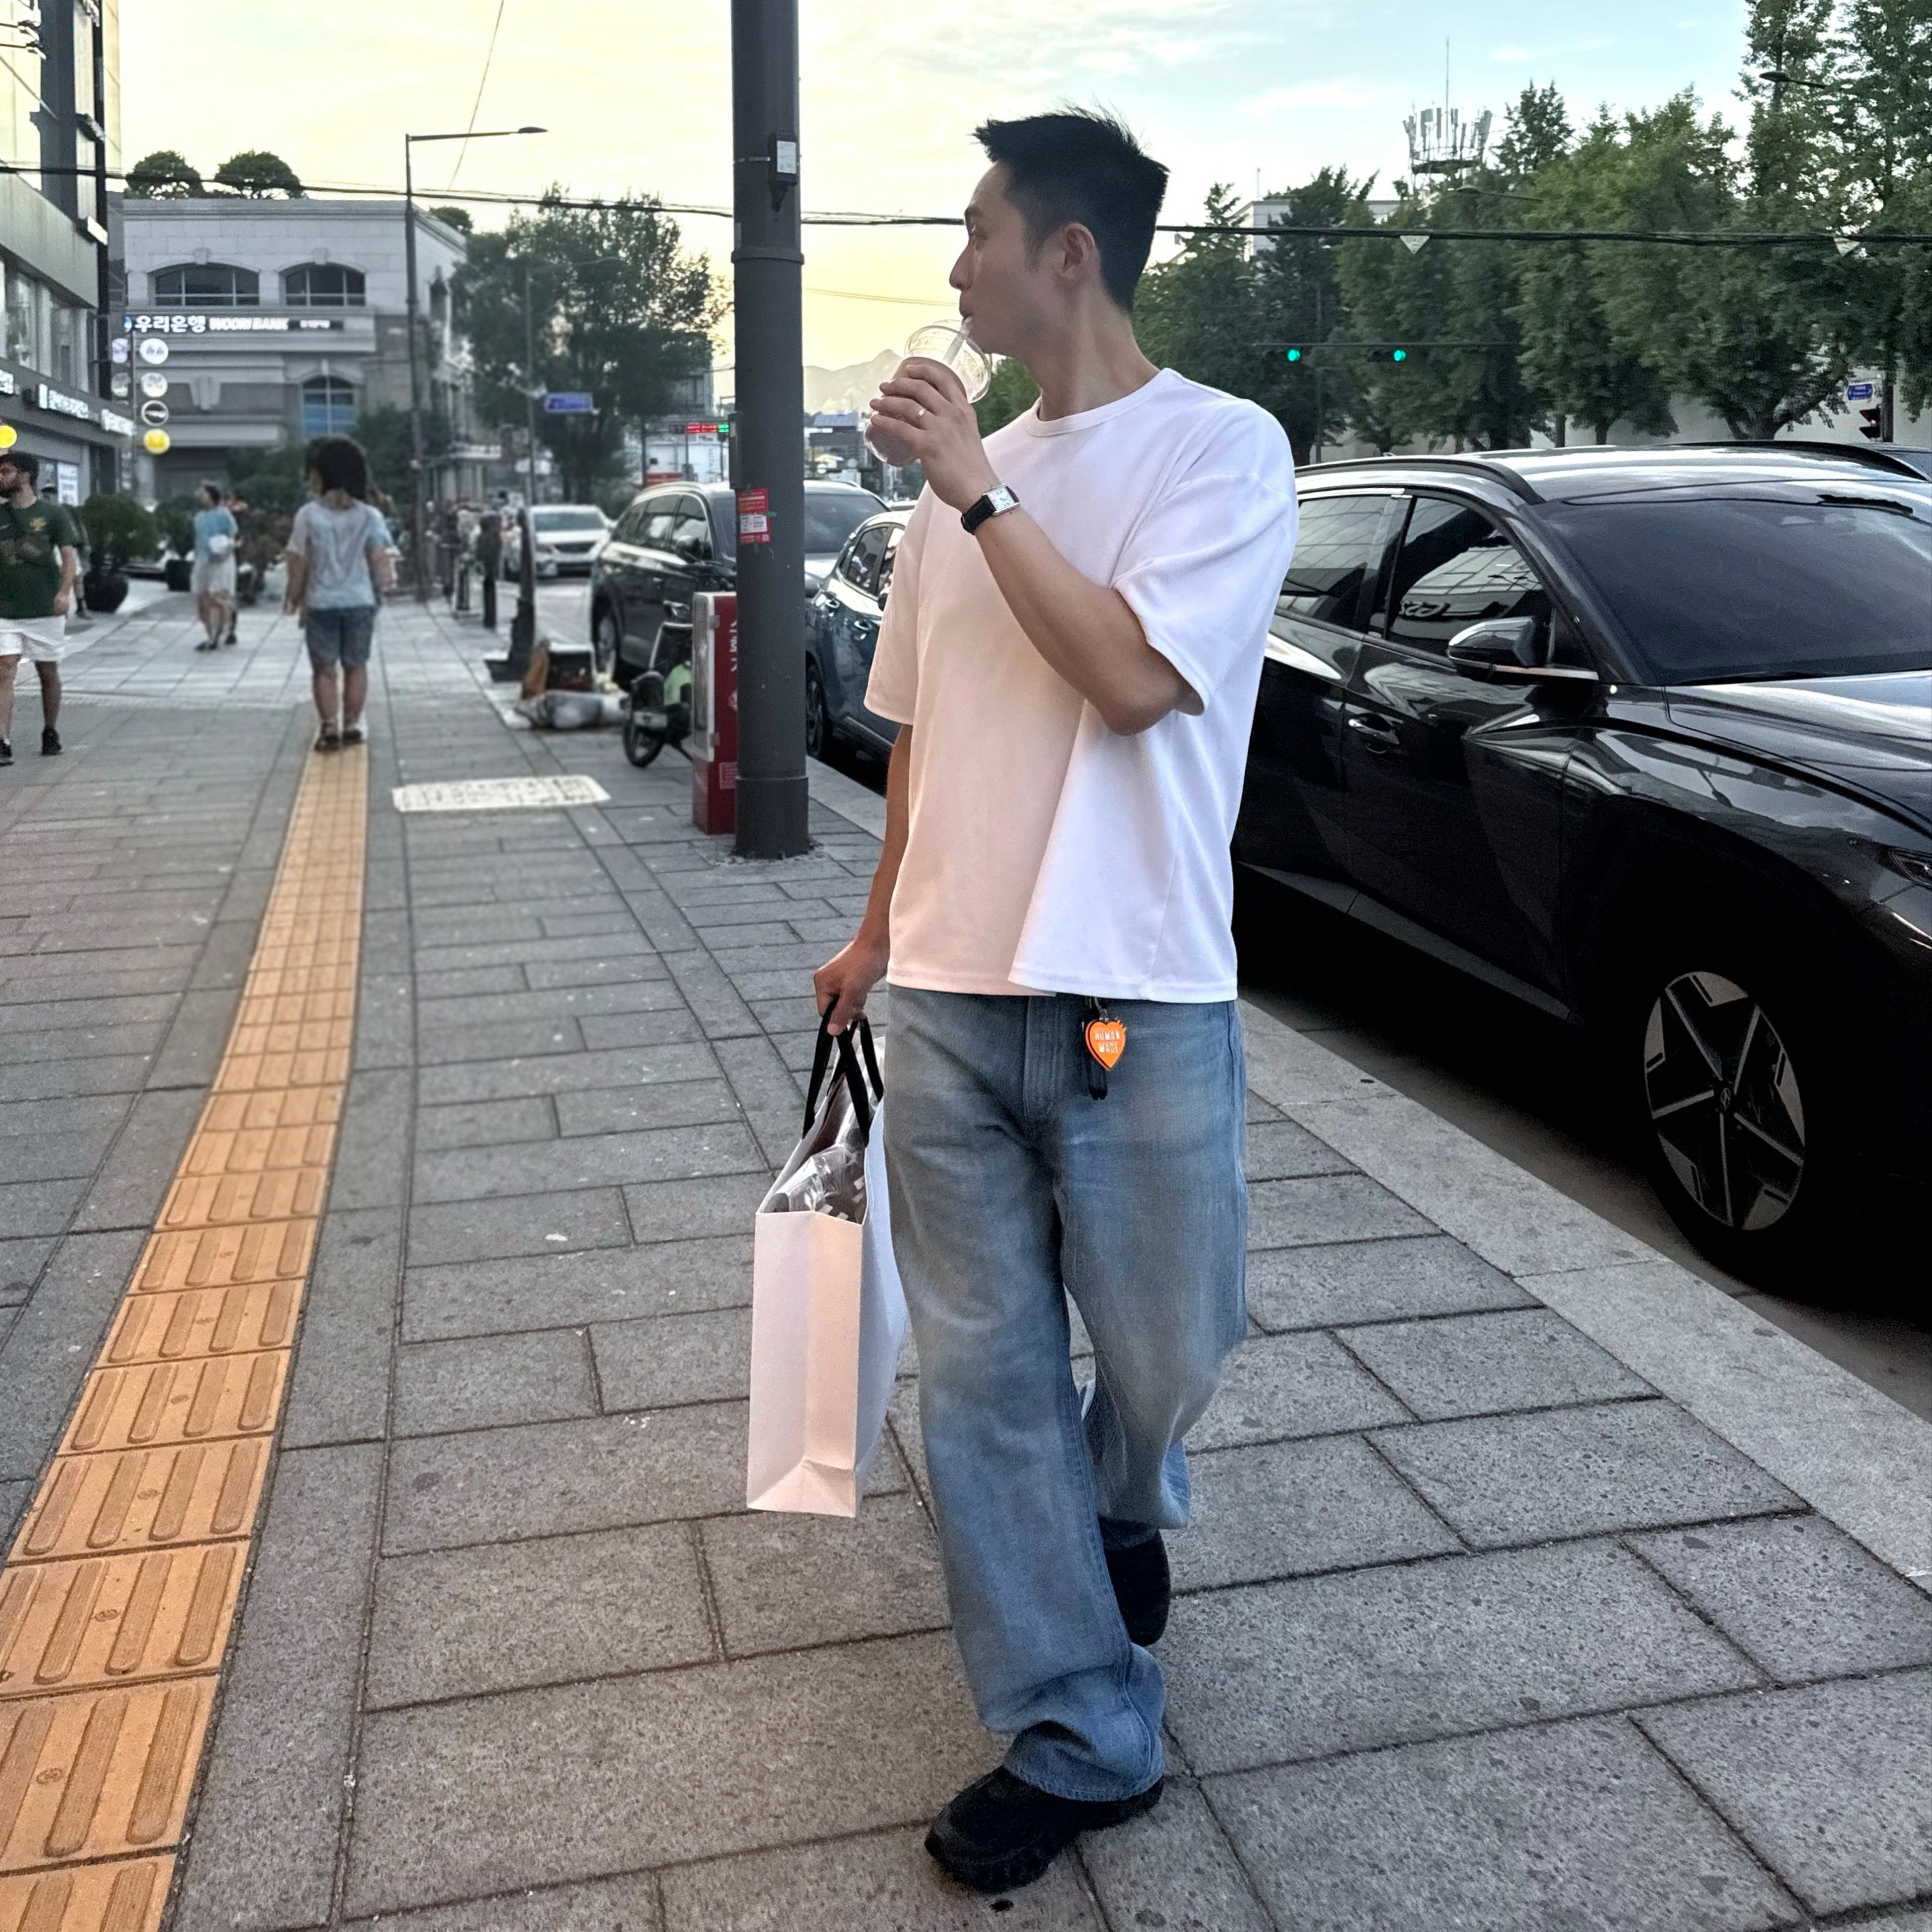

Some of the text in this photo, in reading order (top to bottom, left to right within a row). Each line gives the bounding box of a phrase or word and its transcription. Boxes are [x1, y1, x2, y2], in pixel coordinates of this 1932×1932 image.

[135, 315, 206, 333] 우리은행
[209, 317, 252, 330] WOORI
[252, 317, 290, 330] BANK
[1095, 1029, 1120, 1041] HUMAN
[1099, 1042, 1118, 1054] MADE
